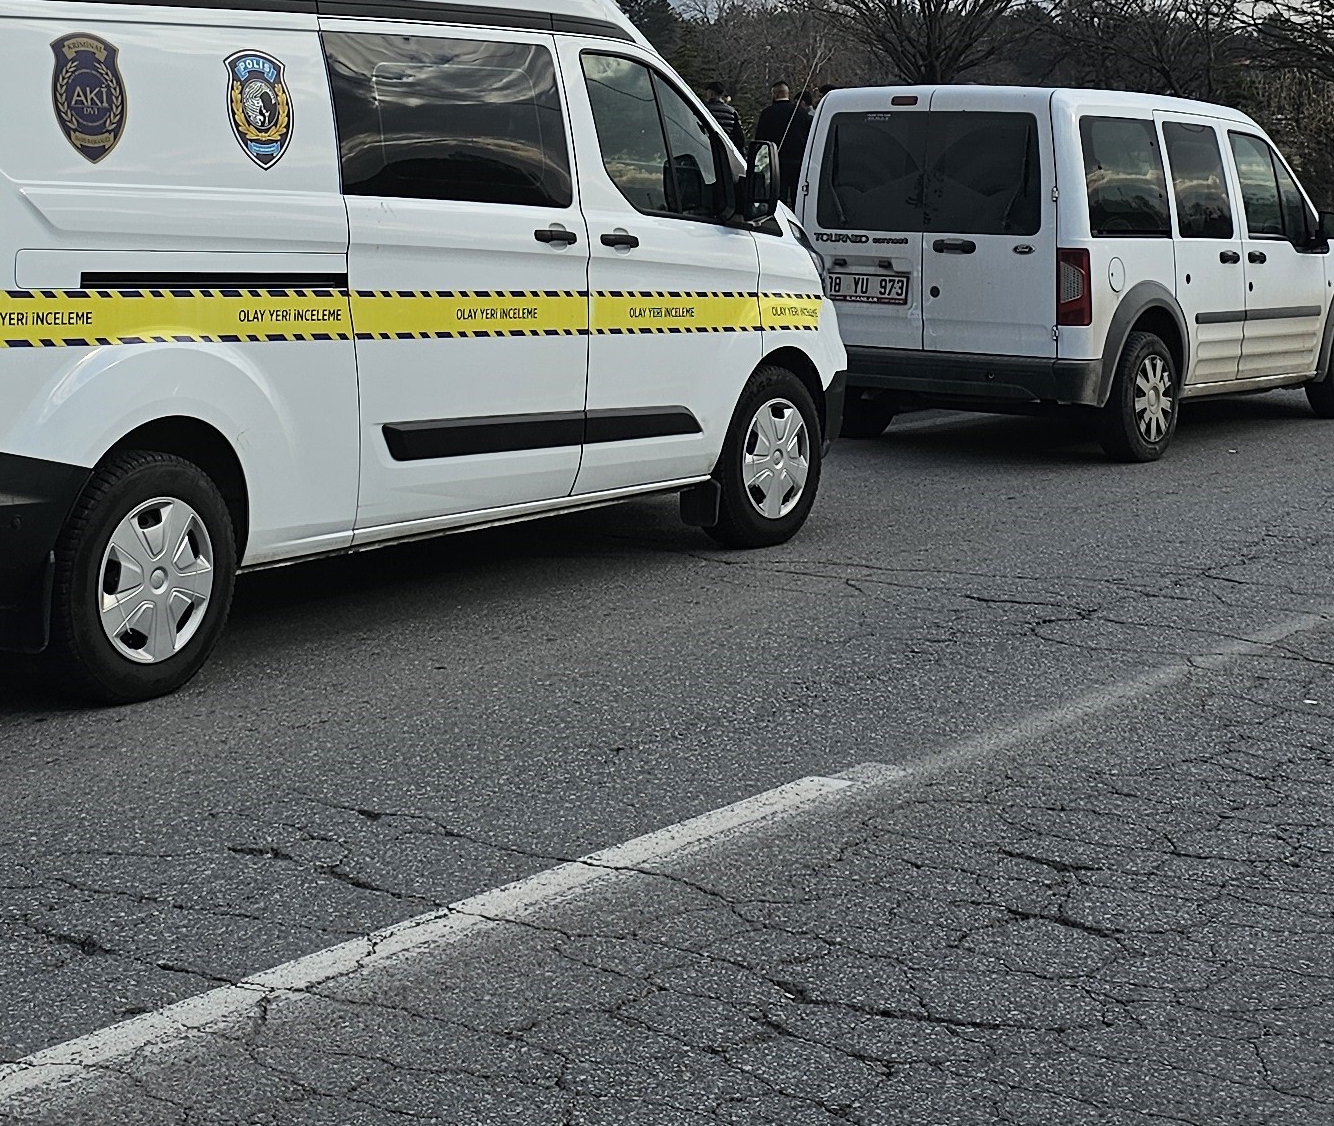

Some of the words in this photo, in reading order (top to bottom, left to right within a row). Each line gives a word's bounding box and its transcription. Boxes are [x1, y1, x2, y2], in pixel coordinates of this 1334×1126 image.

[813, 232, 869, 243] TOURNEO
[853, 276, 869, 294] YU
[878, 278, 905, 297] 973
[238, 309, 266, 322] OLAY
[456, 308, 478, 321] OLAY
[629, 307, 647, 318] OLAY
[771, 306, 786, 317] OLAY
